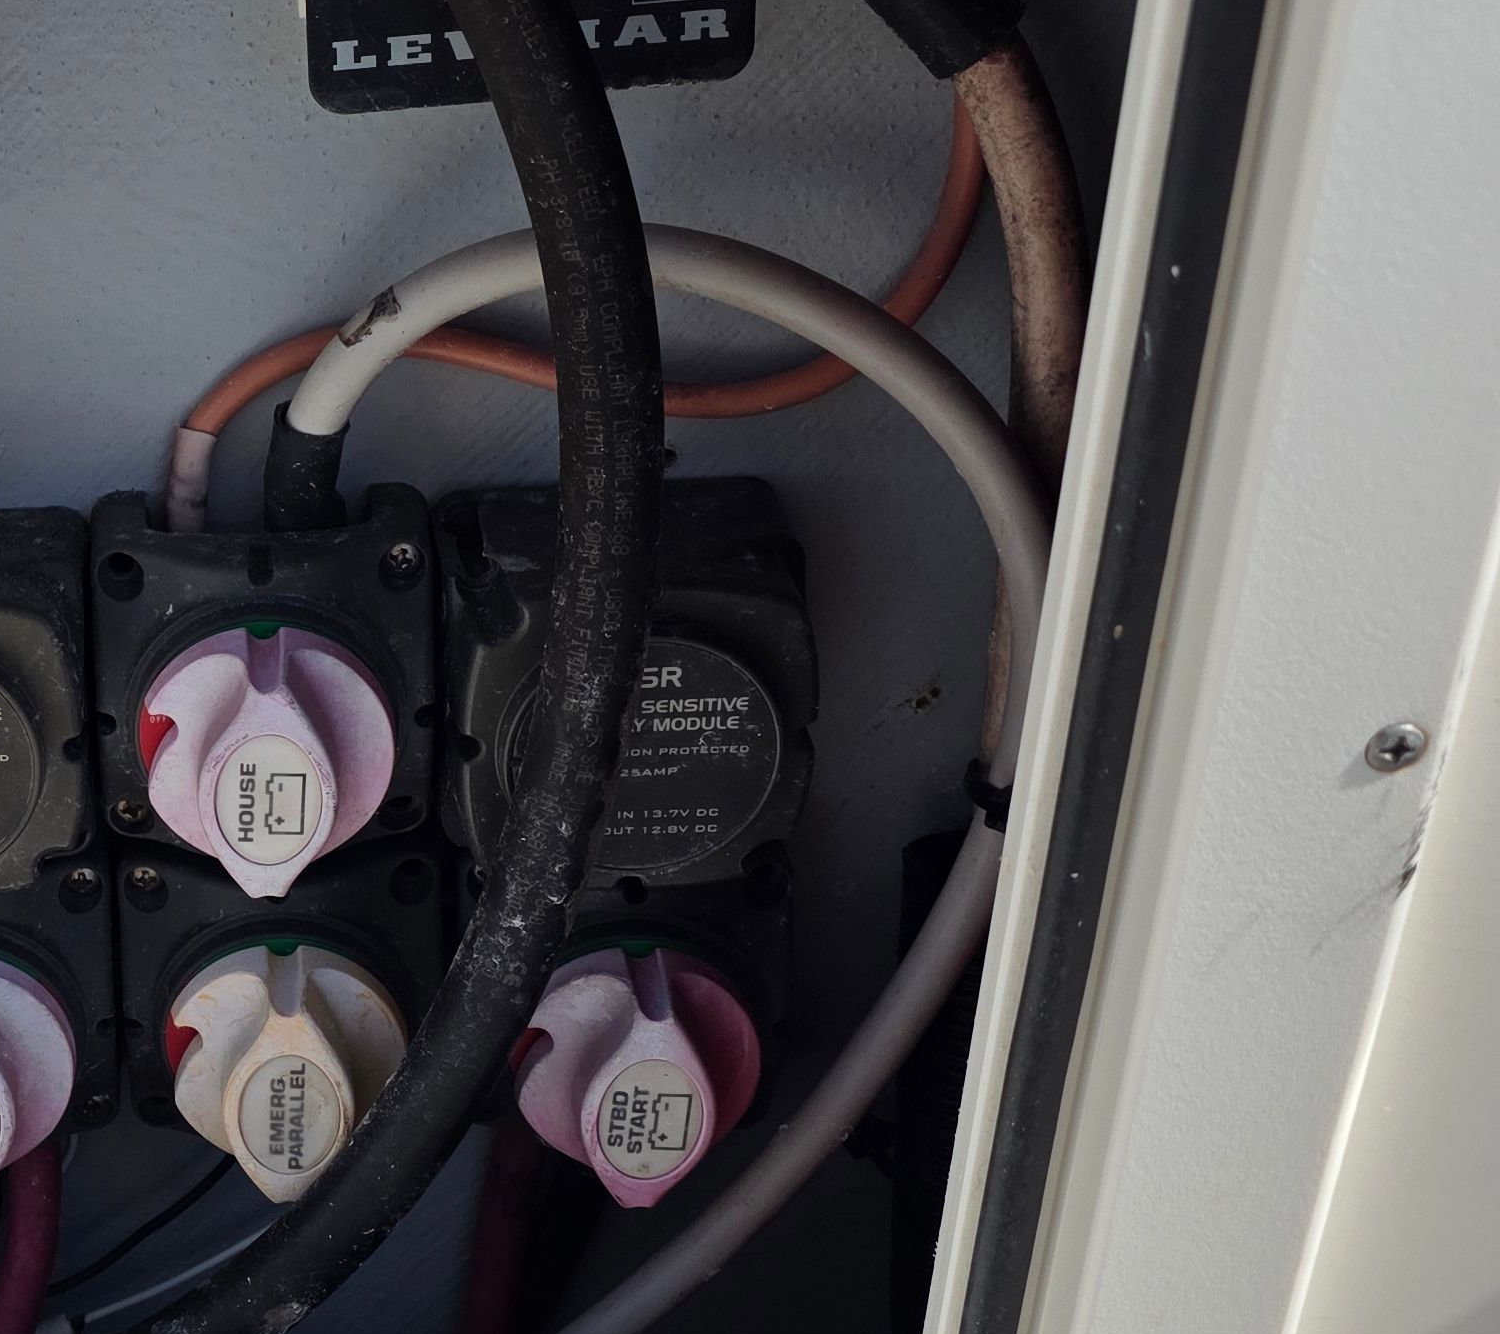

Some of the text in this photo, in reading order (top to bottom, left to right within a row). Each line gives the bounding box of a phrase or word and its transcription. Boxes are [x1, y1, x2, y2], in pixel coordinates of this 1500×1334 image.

[641, 667, 682, 689] SR
[641, 697, 749, 714] SENSITIVE
[653, 716, 740, 732] MODULE
[659, 745, 749, 755] PROTECTED
[620, 767, 678, 777] 25AMP
[238, 763, 256, 842] HOUSE
[618, 809, 719, 819] IN 13.7V DC
[643, 825, 718, 834] 12.8V DC
[269, 1078, 285, 1155] EMERG
[288, 1063, 305, 1169] PARALLEL
[607, 1091, 628, 1147] STBD
[627, 1086, 649, 1154] START
